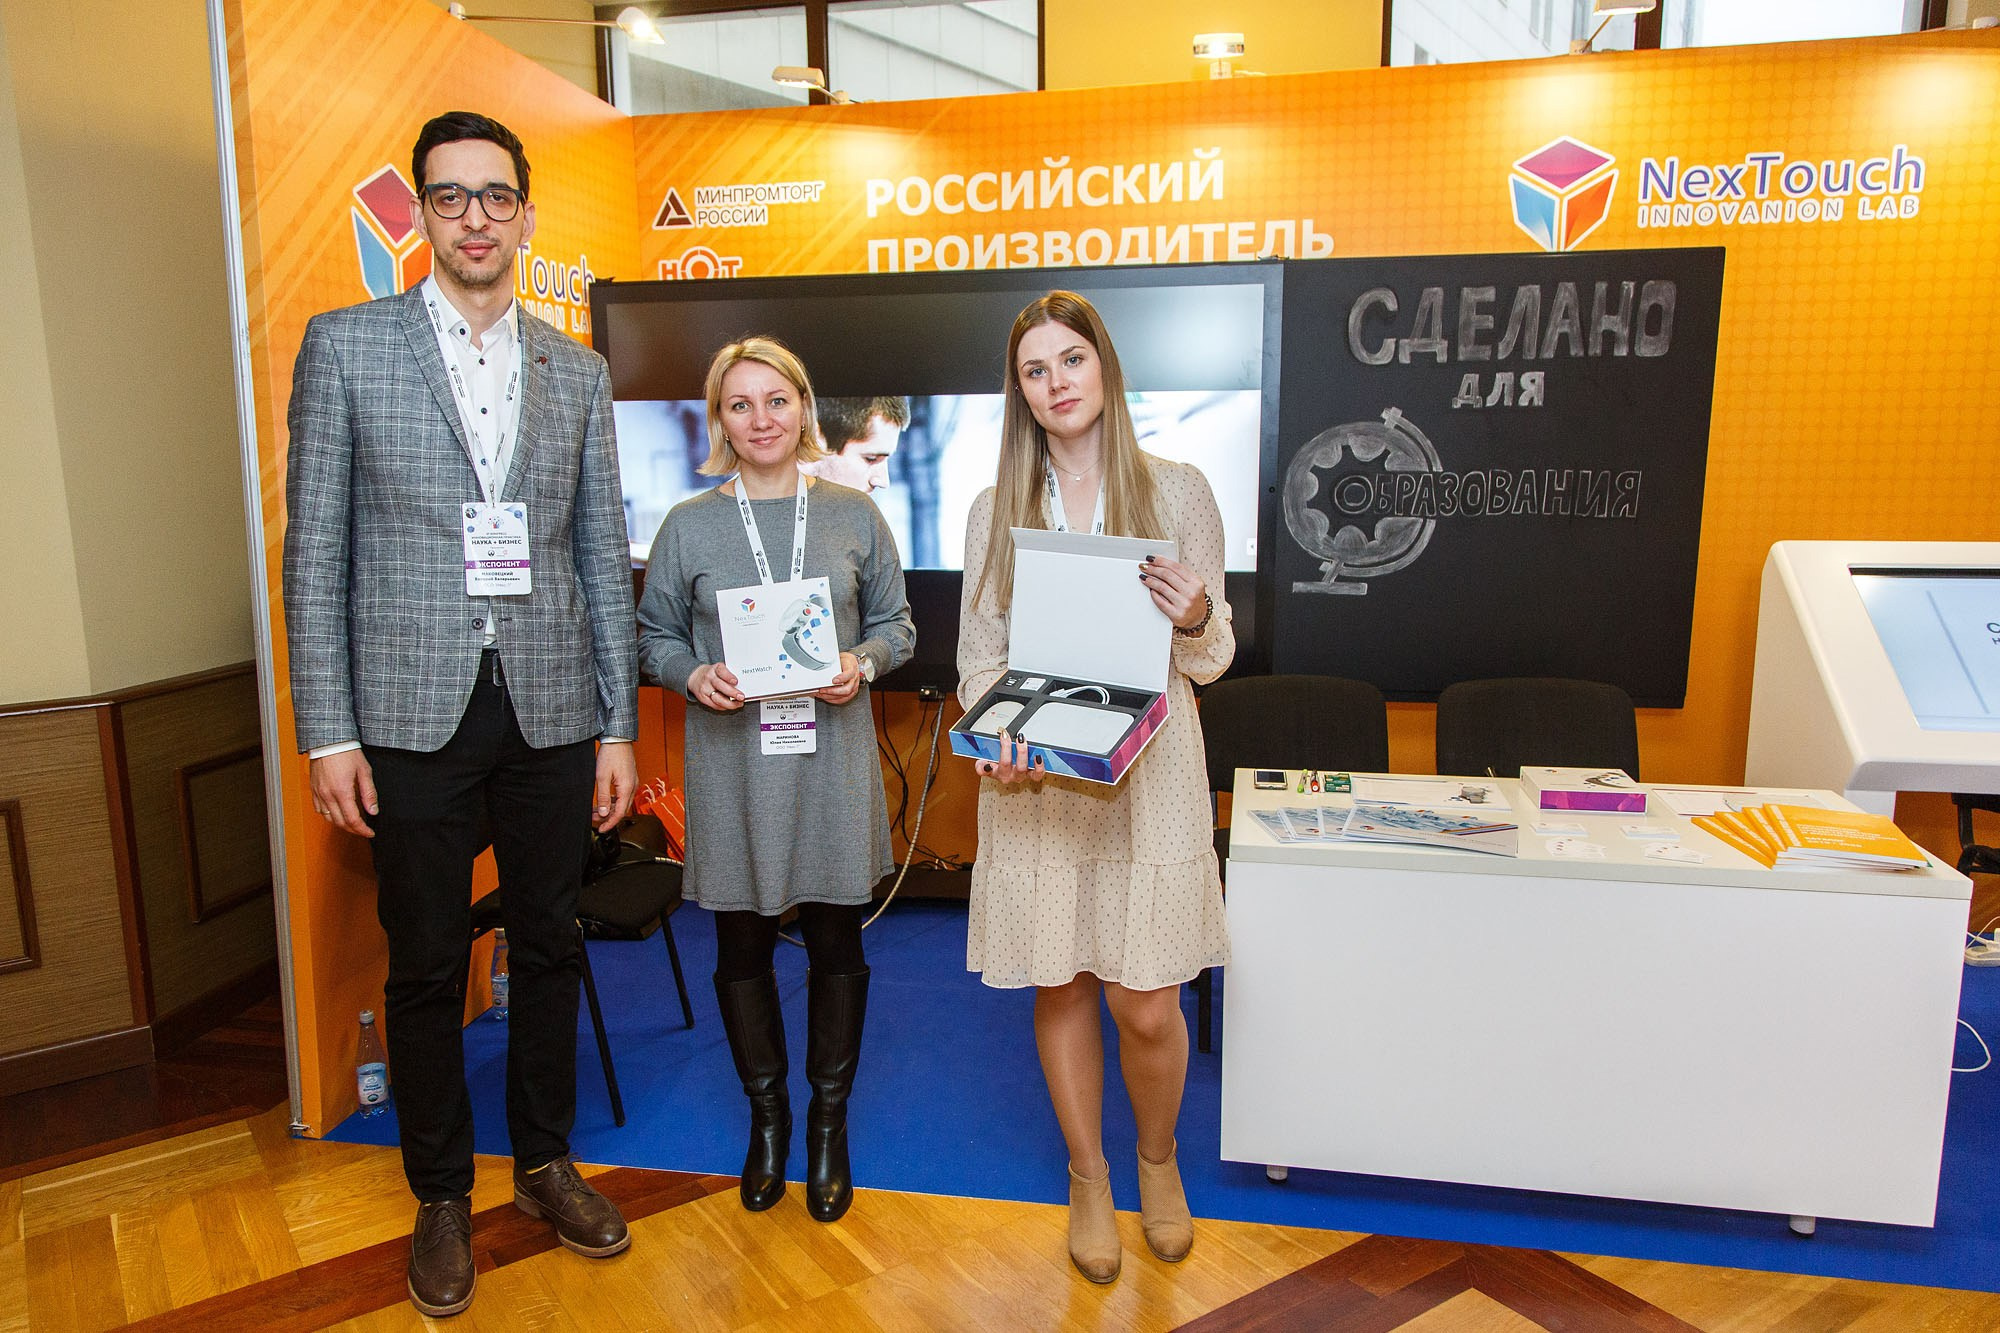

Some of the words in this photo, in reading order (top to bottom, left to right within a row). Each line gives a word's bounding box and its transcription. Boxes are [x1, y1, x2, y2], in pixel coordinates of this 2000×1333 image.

[866, 147, 1225, 218] РОССИЙСКИЙ
[1640, 147, 1923, 201] NexTouch
[696, 182, 824, 205] МИНПРОМТОРГ
[1639, 199, 1842, 226] INNOVANION
[1859, 197, 1918, 218] LAB
[697, 207, 767, 226] РОССИИ
[867, 219, 1335, 272] ПРОИЗВОДИТЕЛЬ
[517, 242, 595, 306] Touch
[571, 308, 591, 334] LA
[1347, 280, 1677, 365] СДЕЛАНО
[1452, 371, 1545, 409] ДЛЯ
[1334, 469, 1642, 518] ОБРАЗОВАНИЯ
[734, 613, 765, 622] NexTouch
[742, 666, 773, 675] NextWatch
